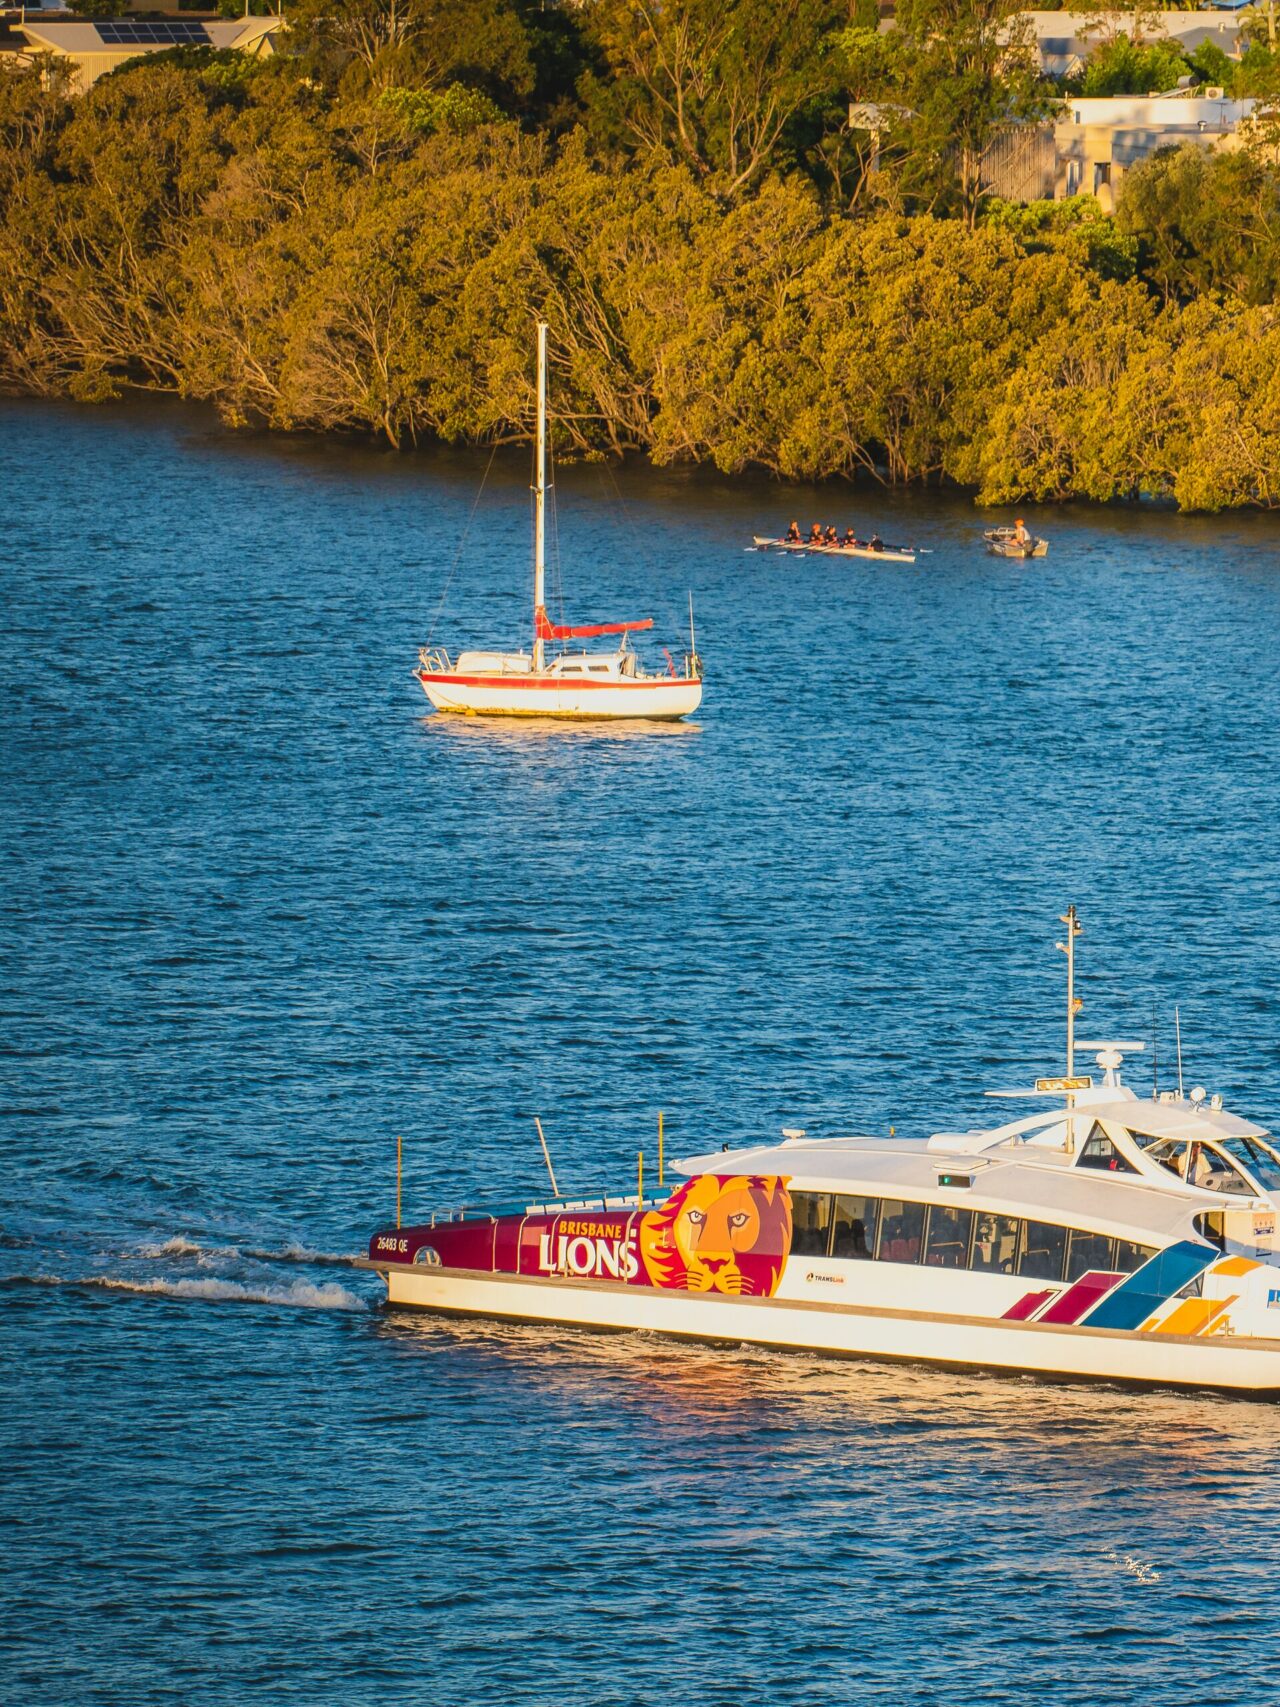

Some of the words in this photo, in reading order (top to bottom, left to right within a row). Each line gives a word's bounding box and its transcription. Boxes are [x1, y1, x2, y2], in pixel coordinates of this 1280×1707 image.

[559, 1221, 621, 1238] BRISBANE
[377, 1237, 397, 1251] 26483
[398, 1239, 408, 1253] QE
[539, 1234, 638, 1278] LIONS
